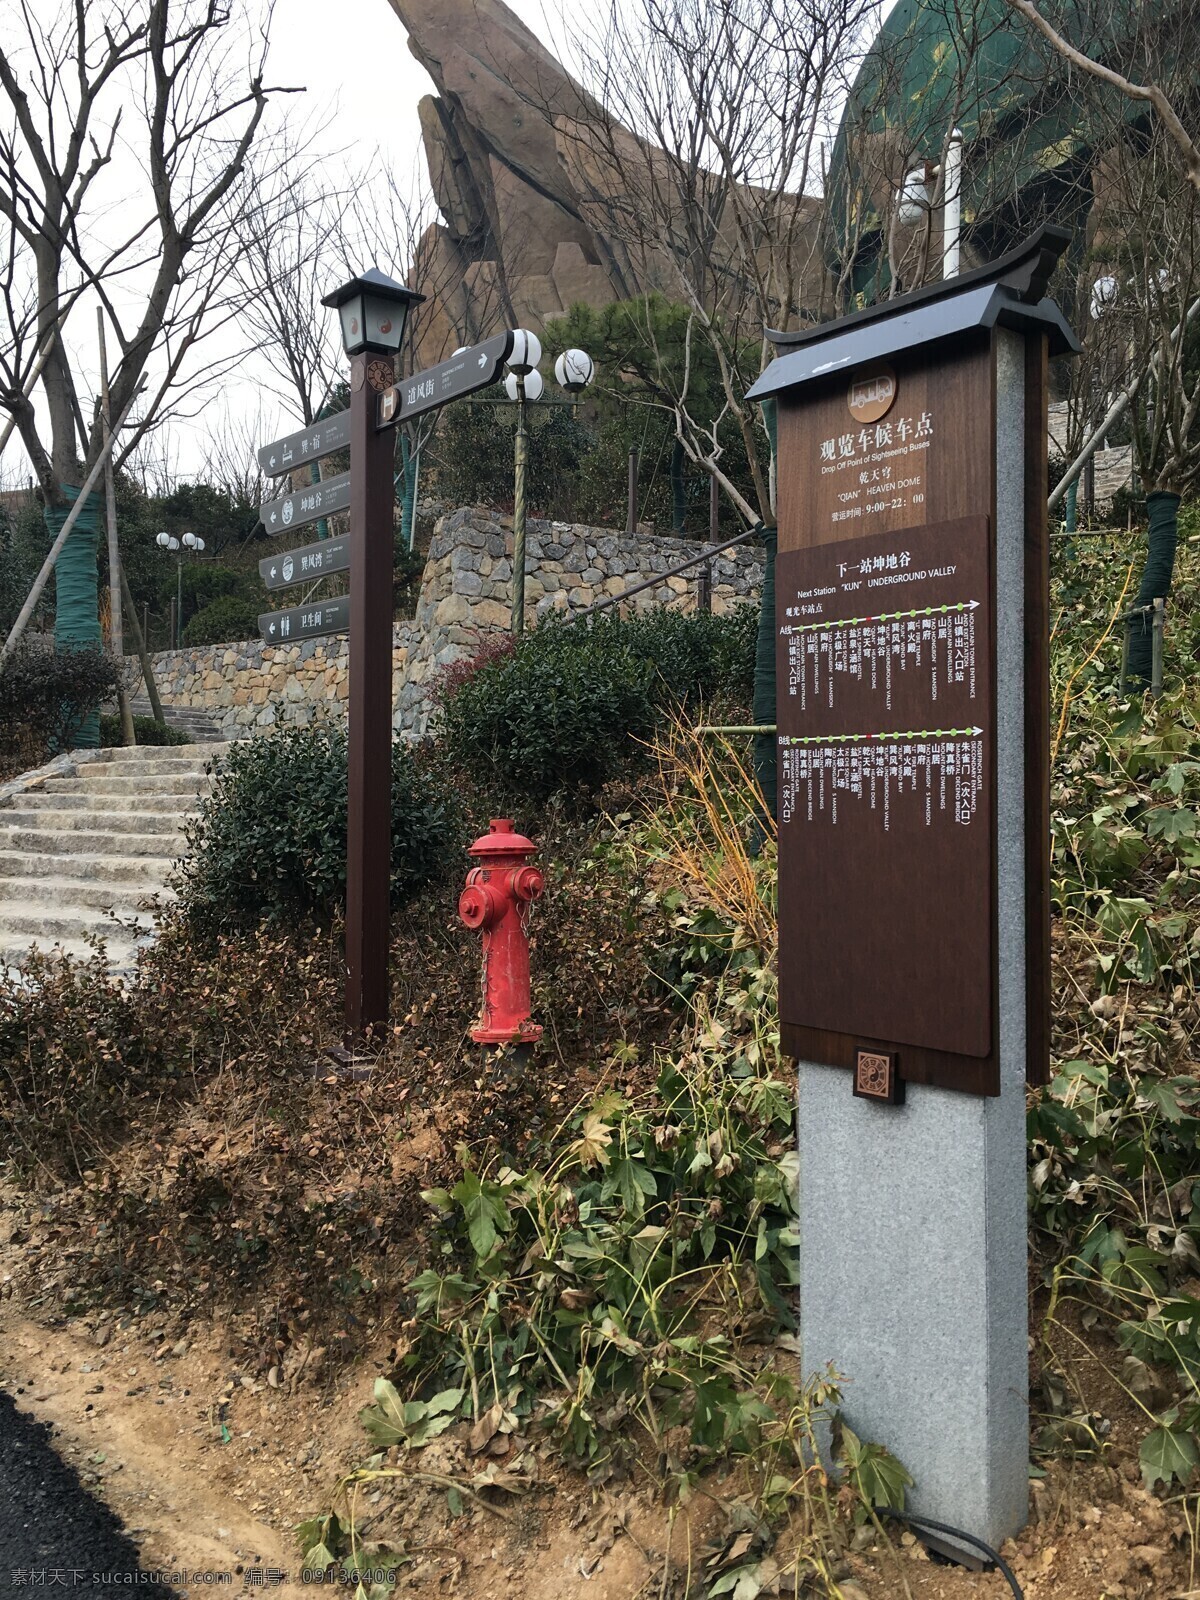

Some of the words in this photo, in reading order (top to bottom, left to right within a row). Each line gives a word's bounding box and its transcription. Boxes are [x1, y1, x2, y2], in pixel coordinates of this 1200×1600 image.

[408, 379, 434, 405] 道风街
[819, 412, 934, 462] 观览车候车点
[822, 462, 836, 474] Drop
[837, 461, 847, 470] Off
[847, 457, 863, 468] Point
[864, 455, 871, 464] of
[871, 446, 908, 462] Sightseeing
[910, 440, 930, 452] Buses
[859, 466, 892, 484] 乾天穹
[866, 482, 896, 496] HEAVEN
[897, 476, 921, 489] DOME
[301, 492, 322, 512] 坤地谷
[302, 552, 322, 571] 巽风湾
[836, 551, 911, 578] 下一站坤地谷
[798, 590, 812, 598] Next
[814, 586, 836, 596] Station
[868, 570, 926, 587] UNDERGROUND
[928, 566, 956, 578] VALLEY
[301, 612, 322, 628] 卫生间
[922, 619, 931, 640] 陶府
[938, 617, 947, 639] 山居
[807, 634, 815, 654] 山居
[821, 632, 828, 652] 陶府
[877, 625, 886, 656] 坤地谷
[892, 622, 900, 654] 巽风湾
[955, 615, 964, 681] 山镇出入口站
[812, 749, 820, 768] 山居
[824, 748, 832, 767] 陶府
[876, 746, 884, 777] 坤地谷
[889, 745, 898, 776] 巽风湾
[917, 744, 926, 764] 陶府
[932, 744, 940, 764] 山居
